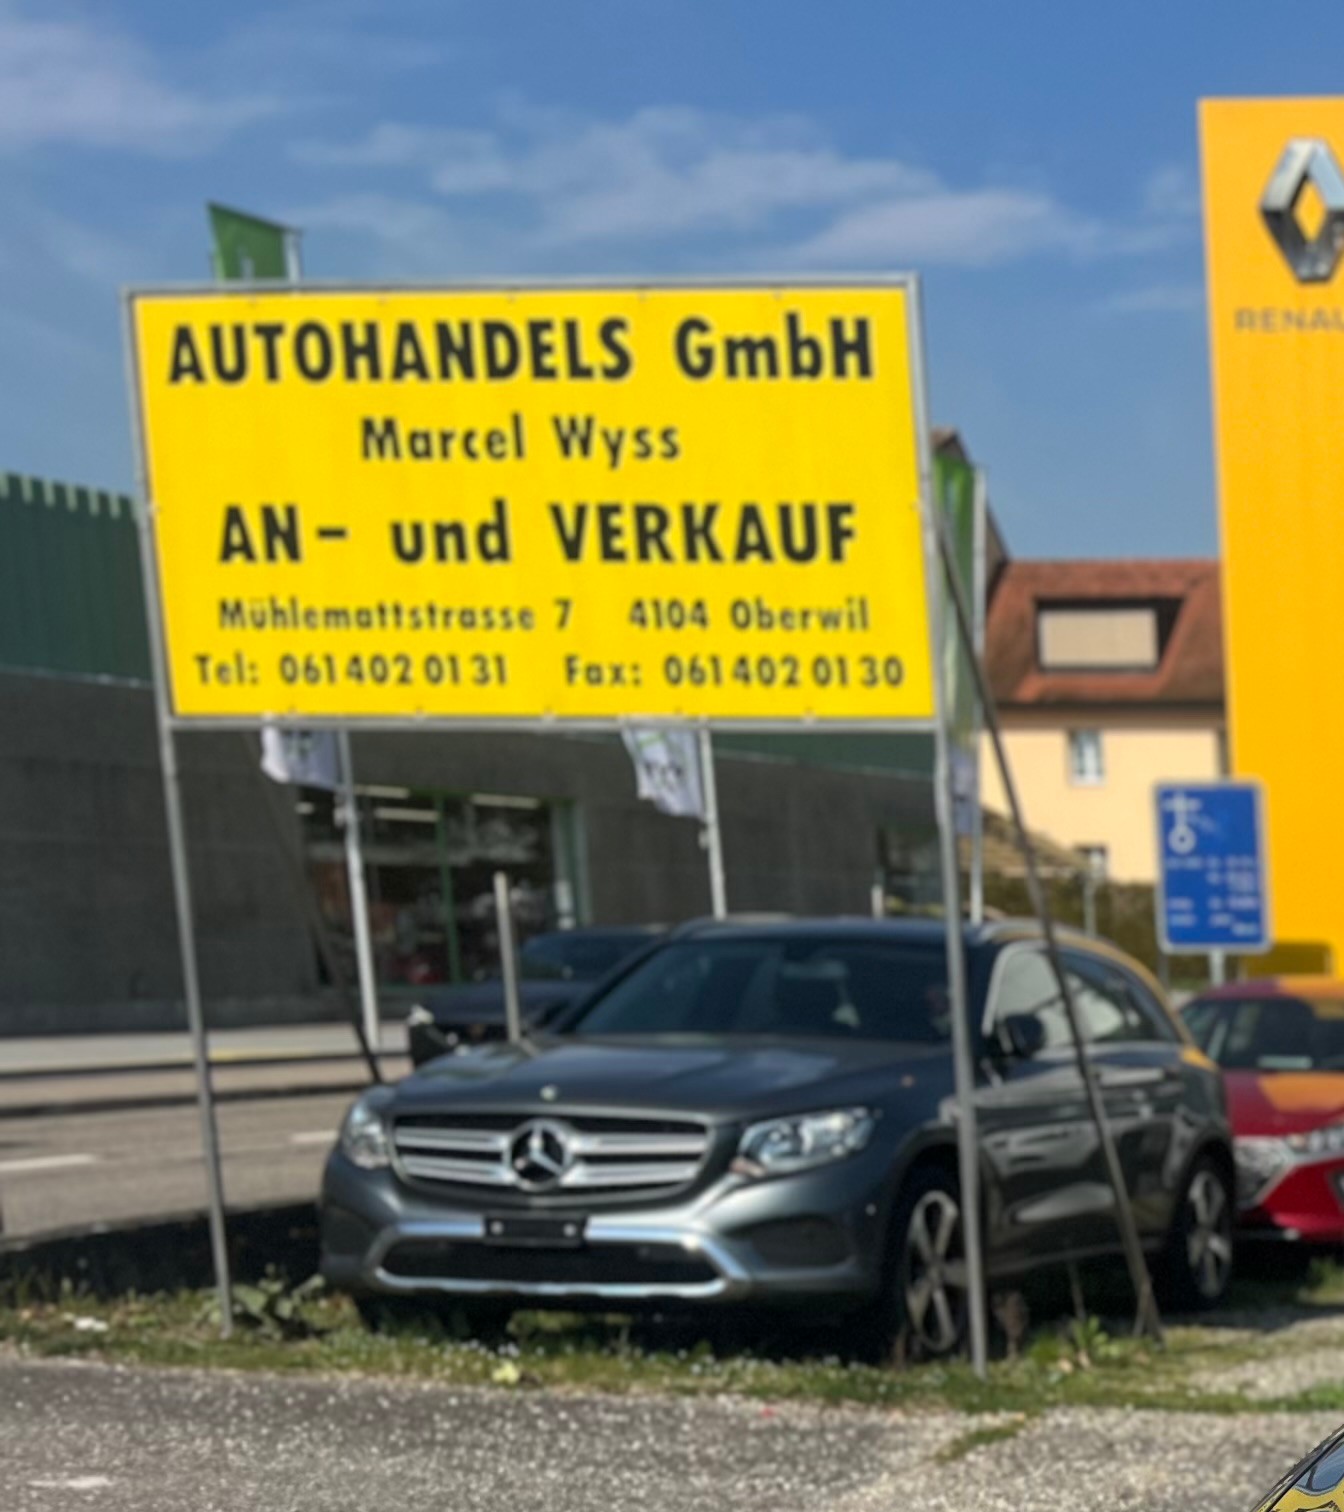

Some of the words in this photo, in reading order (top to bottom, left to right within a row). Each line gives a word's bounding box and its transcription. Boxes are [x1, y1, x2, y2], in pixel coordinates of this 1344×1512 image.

[168, 316, 633, 385] AUTOHANDELS
[674, 311, 874, 381] GmbH
[361, 411, 525, 462] Marcel
[551, 414, 681, 470] Wyss
[390, 497, 511, 565] und
[549, 502, 857, 565] VERKAUF
[218, 598, 535, 631] Mühlemattstrasse
[553, 598, 573, 630] 7
[629, 598, 709, 631] 4104
[729, 597, 869, 631] Oberwil
[194, 653, 260, 685] Tel:
[563, 654, 643, 687] Fax:
